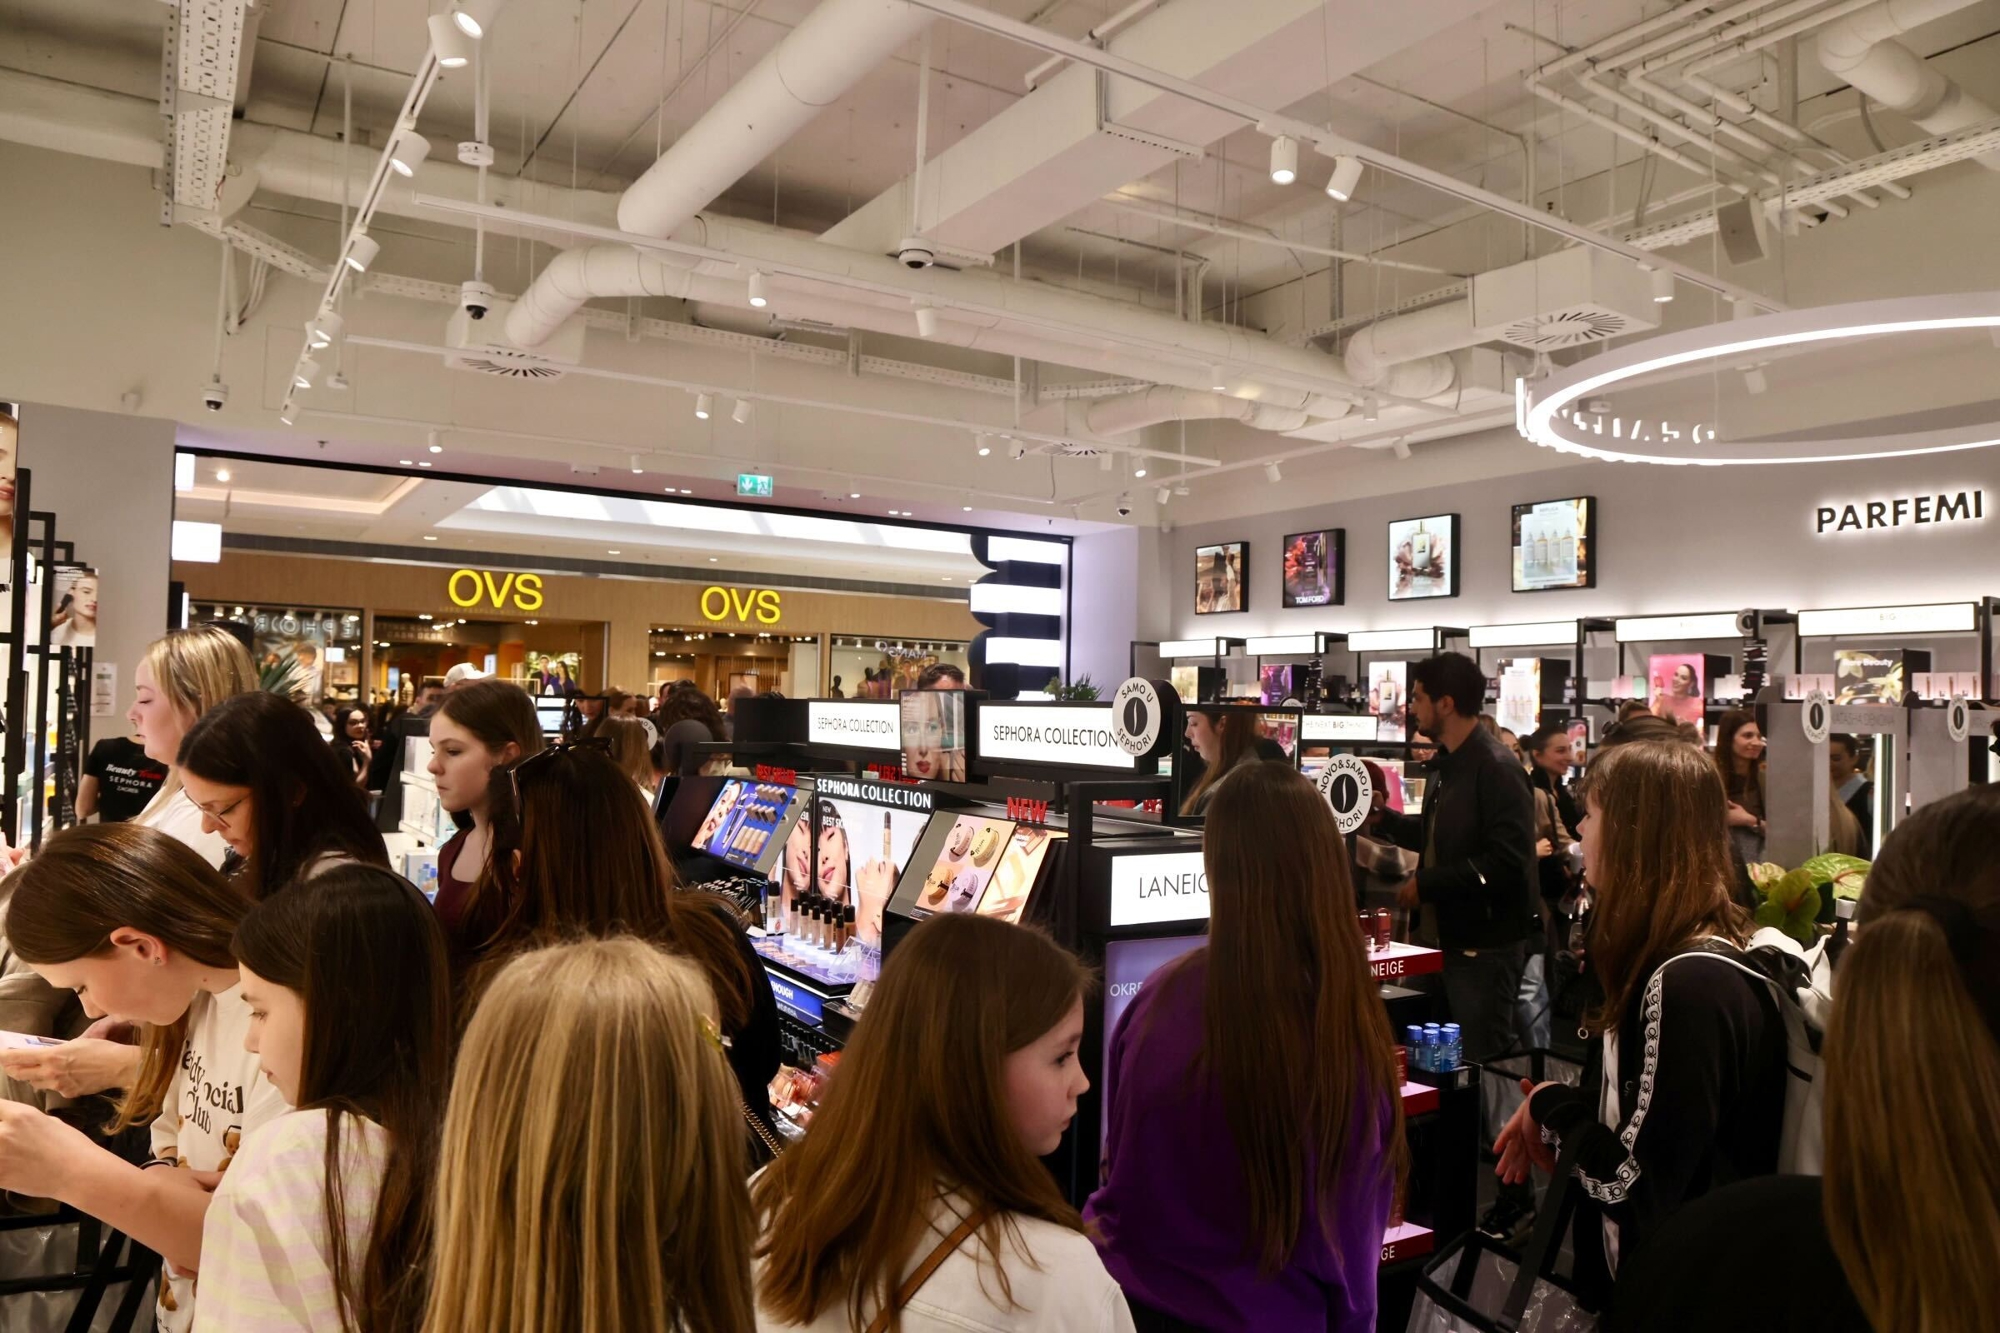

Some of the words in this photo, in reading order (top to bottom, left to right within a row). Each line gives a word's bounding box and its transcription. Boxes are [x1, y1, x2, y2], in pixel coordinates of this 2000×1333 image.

[1817, 490, 1982, 533] PARFEMI
[448, 569, 543, 610] OVS
[701, 586, 780, 624] OVS
[1863, 658, 1893, 668] Beauty
[1121, 682, 1146, 699] SAMO
[1146, 692, 1154, 704] U
[817, 716, 848, 731] SEPHORA
[849, 718, 894, 734] COLLECTION
[1332, 721, 1345, 729] BIG
[993, 725, 1041, 743] SEPHORA
[1044, 727, 1118, 749] COLLECTION
[1116, 728, 1152, 751] SEPHORI
[105, 763, 137, 777] Beauty
[108, 776, 153, 788] SEPHORA
[817, 778, 860, 798] SEPHORA
[861, 784, 931, 809] COLLECTION
[1362, 788, 1369, 797] U
[1007, 796, 1049, 824] NEW
[822, 815, 835, 827] BEST
[1370, 960, 1405, 978] NEIGE
